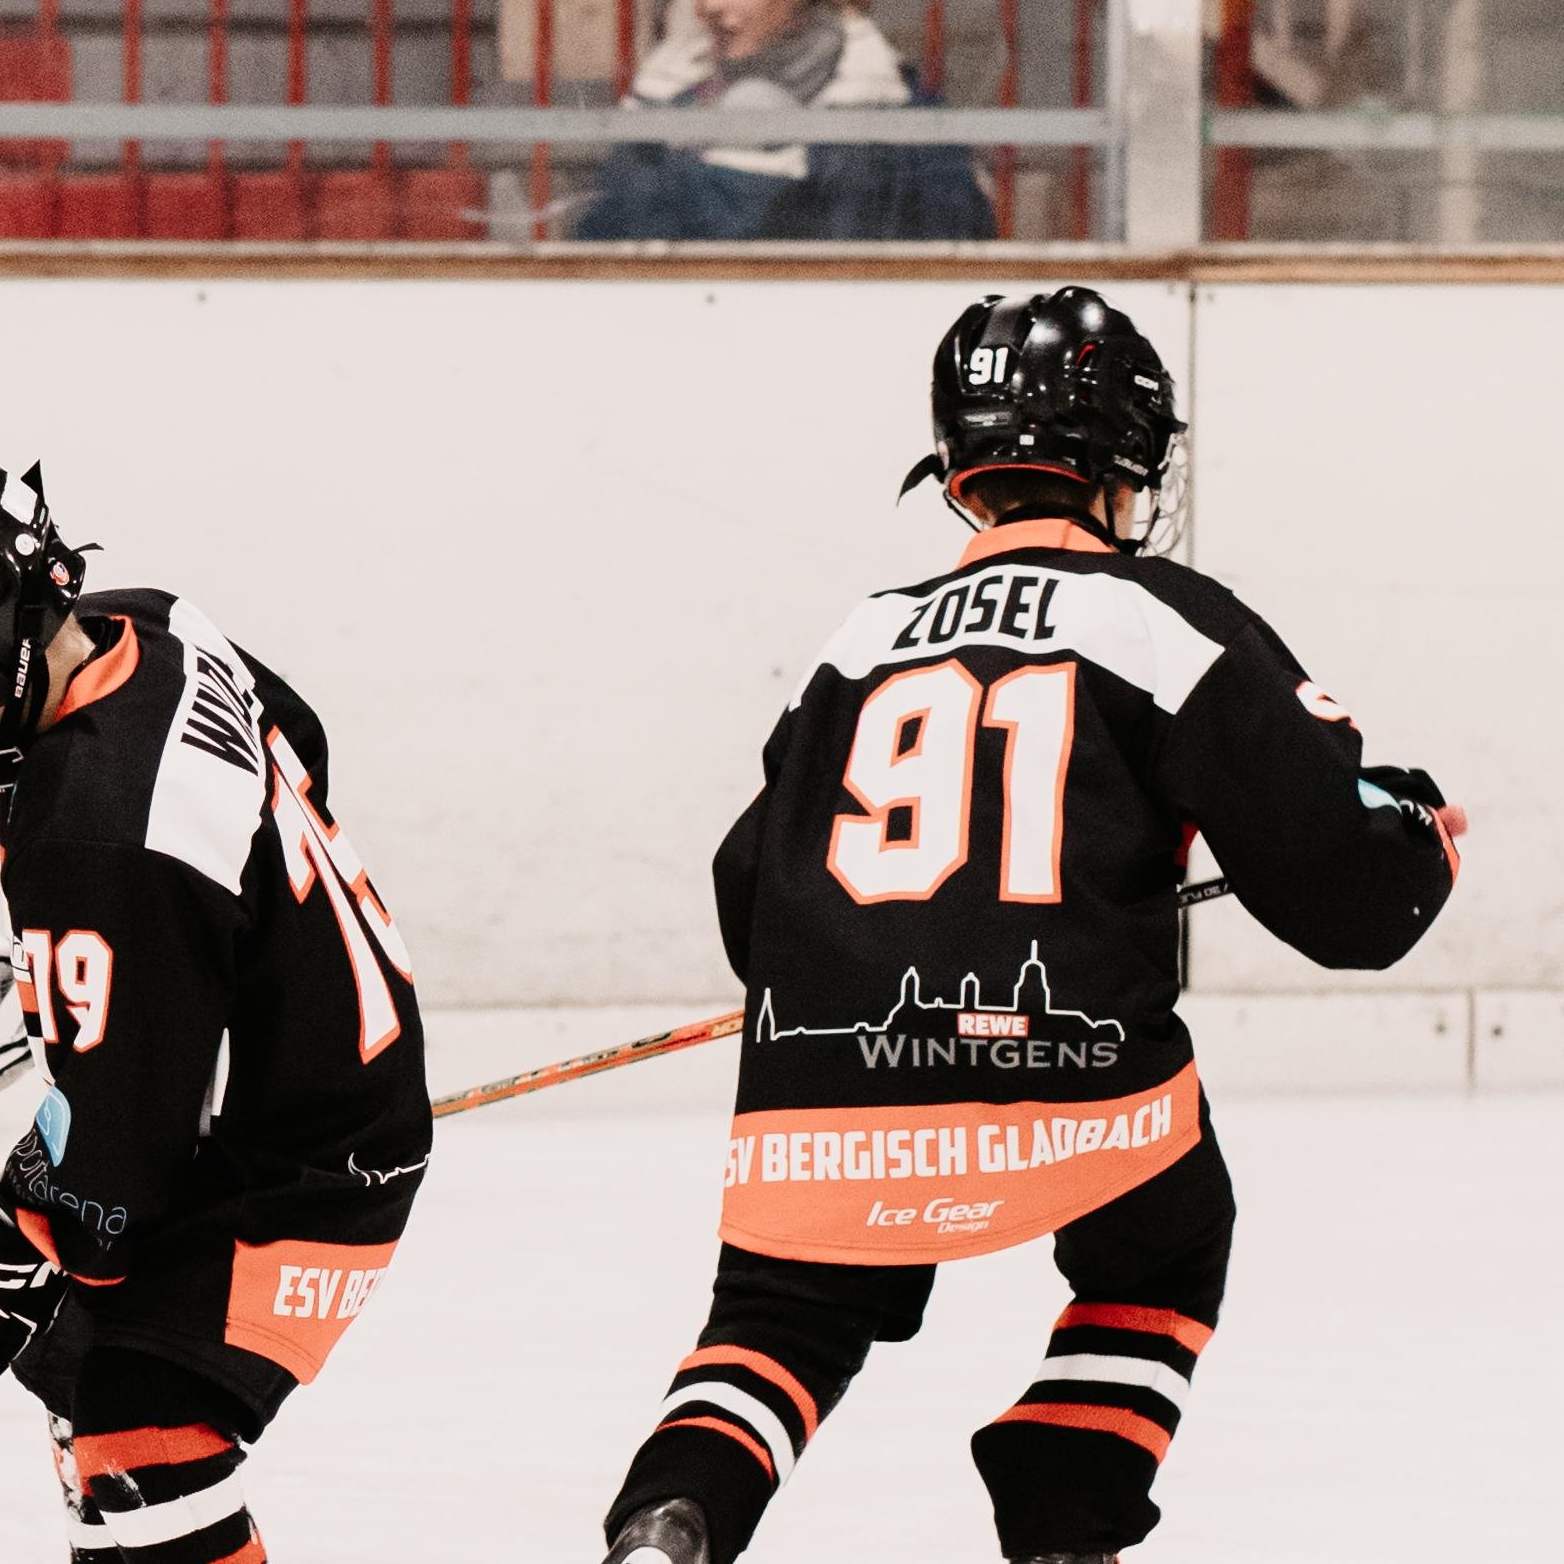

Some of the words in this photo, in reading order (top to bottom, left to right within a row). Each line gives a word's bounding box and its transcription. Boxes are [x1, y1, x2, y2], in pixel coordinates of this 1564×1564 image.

[968, 347, 1009, 386] 91
[891, 574, 1061, 651] ZOSEL
[826, 657, 1078, 906] 91
[958, 1013, 1028, 1035] REWE
[858, 1034, 1120, 1069] WINTGENS
[762, 1126, 967, 1183] BERGISCH
[978, 1094, 1172, 1175] GLADBACH
[866, 1200, 918, 1227] Ice
[923, 1197, 1005, 1223] Gear
[937, 1219, 990, 1235] Design
[273, 1264, 343, 1320] ESV
